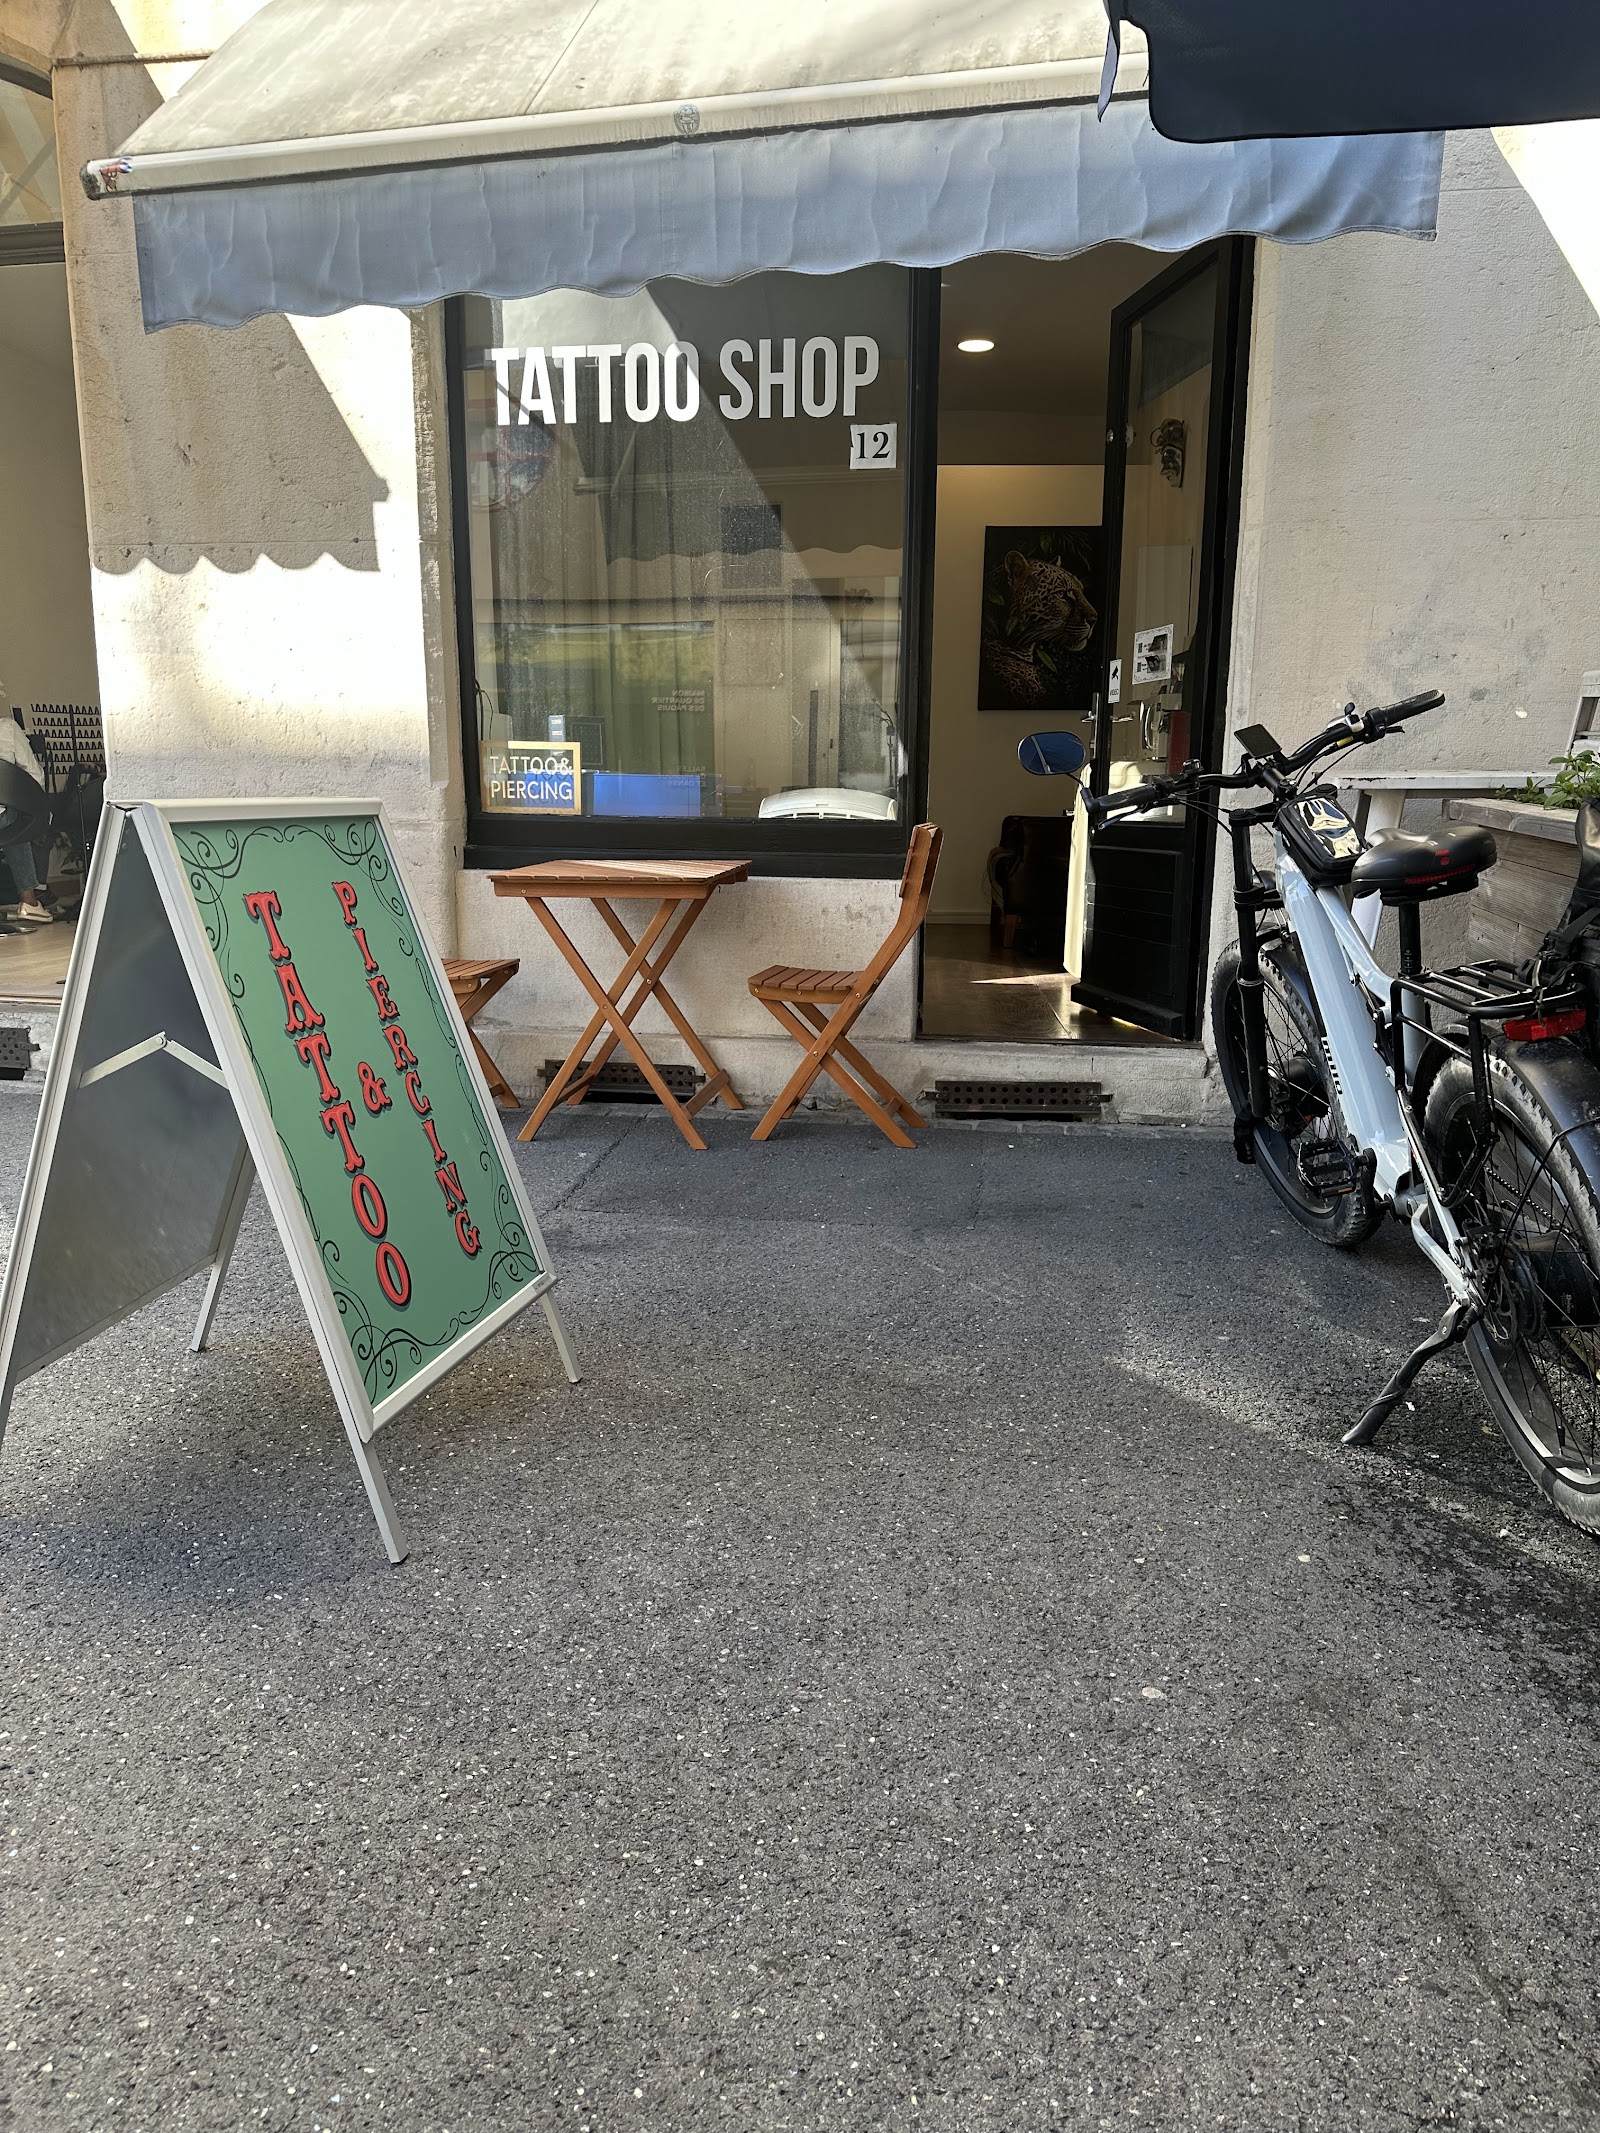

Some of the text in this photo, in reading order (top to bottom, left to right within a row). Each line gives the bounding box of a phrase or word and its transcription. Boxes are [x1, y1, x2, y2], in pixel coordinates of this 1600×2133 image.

[485, 335, 880, 426] TATTOO SHOP
[856, 431, 891, 460] 12
[491, 780, 572, 800] PIERCING
[243, 891, 412, 1309] TATTOO
[331, 881, 483, 1258] PIERCING
[357, 1061, 393, 1115] &
